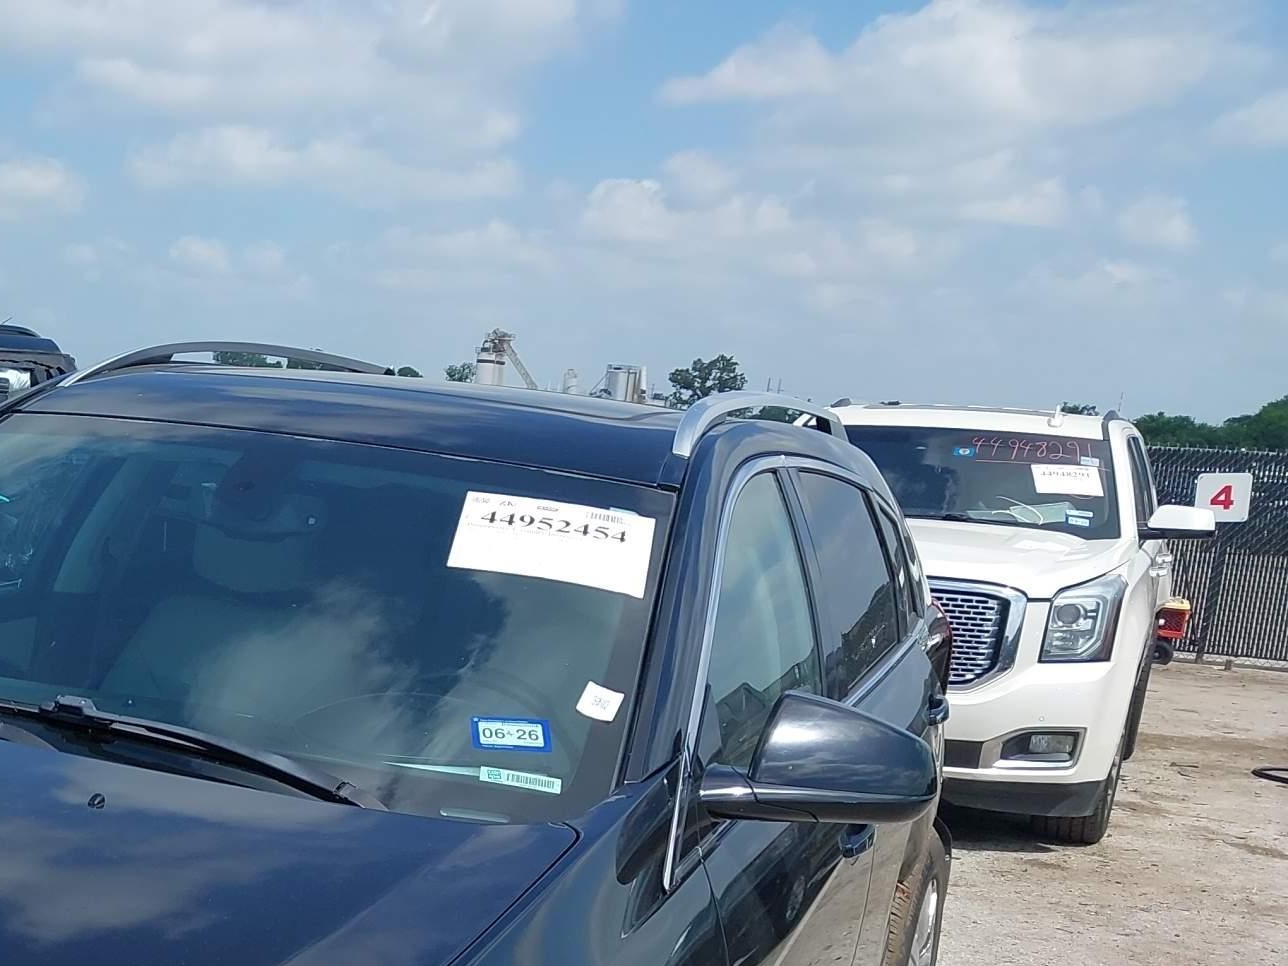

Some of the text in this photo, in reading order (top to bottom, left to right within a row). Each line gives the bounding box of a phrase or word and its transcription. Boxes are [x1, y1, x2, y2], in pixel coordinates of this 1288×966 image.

[972, 436, 1092, 463] 44948291
[1209, 484, 1235, 511] 4
[480, 510, 628, 543] 44952454
